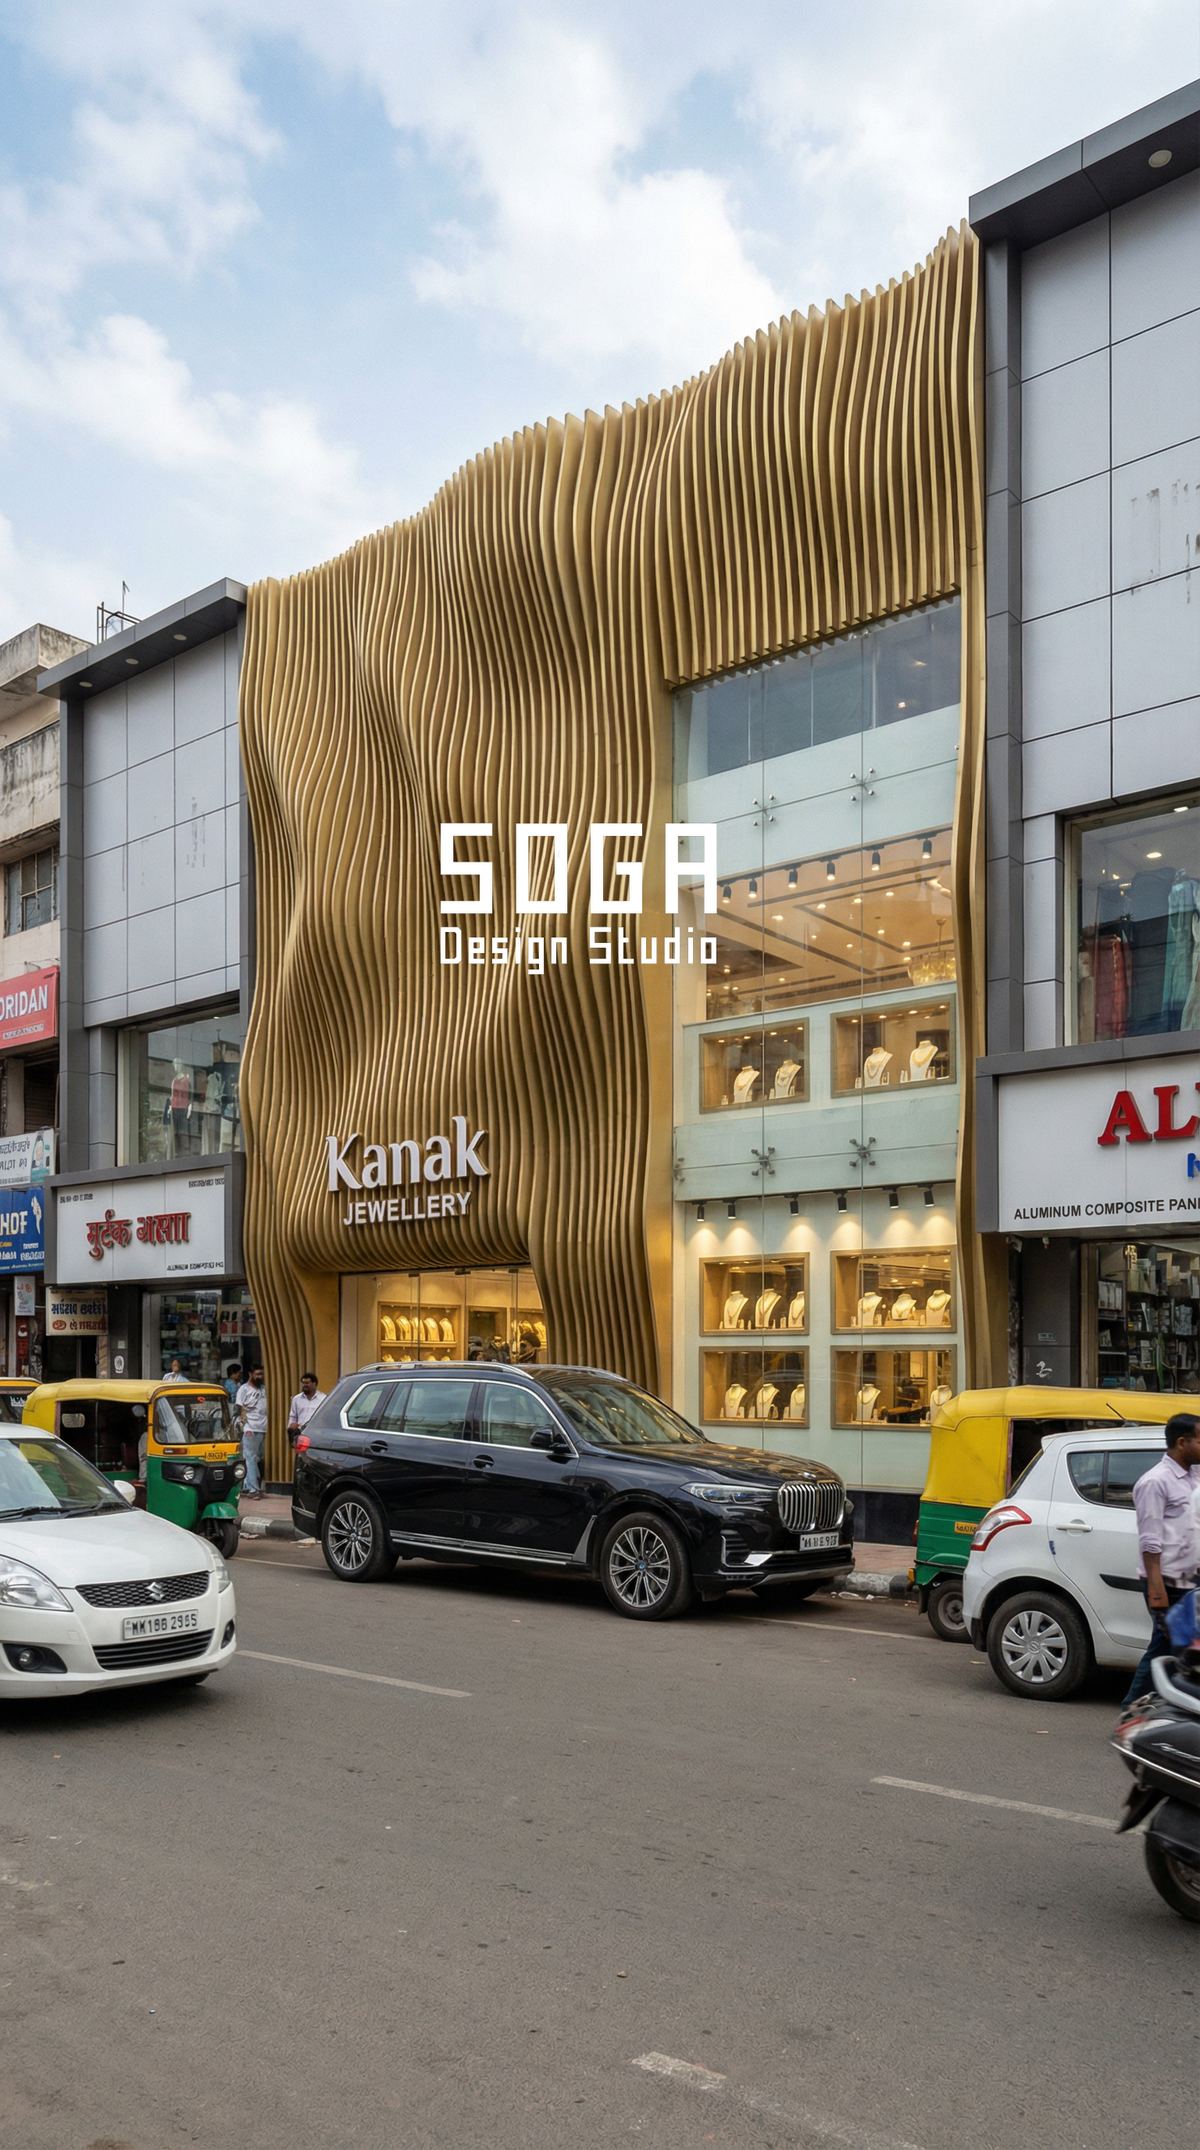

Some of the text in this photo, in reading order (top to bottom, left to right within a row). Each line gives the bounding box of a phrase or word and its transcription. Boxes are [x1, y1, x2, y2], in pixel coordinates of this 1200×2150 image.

[1097, 1082, 1200, 1146] AL
[325, 1115, 490, 1192] Kanak
[343, 1191, 472, 1226] JEWELLERY
[1014, 1204, 1081, 1220] ALUMINUM
[1085, 1199, 1165, 1216] COMPOSITE
